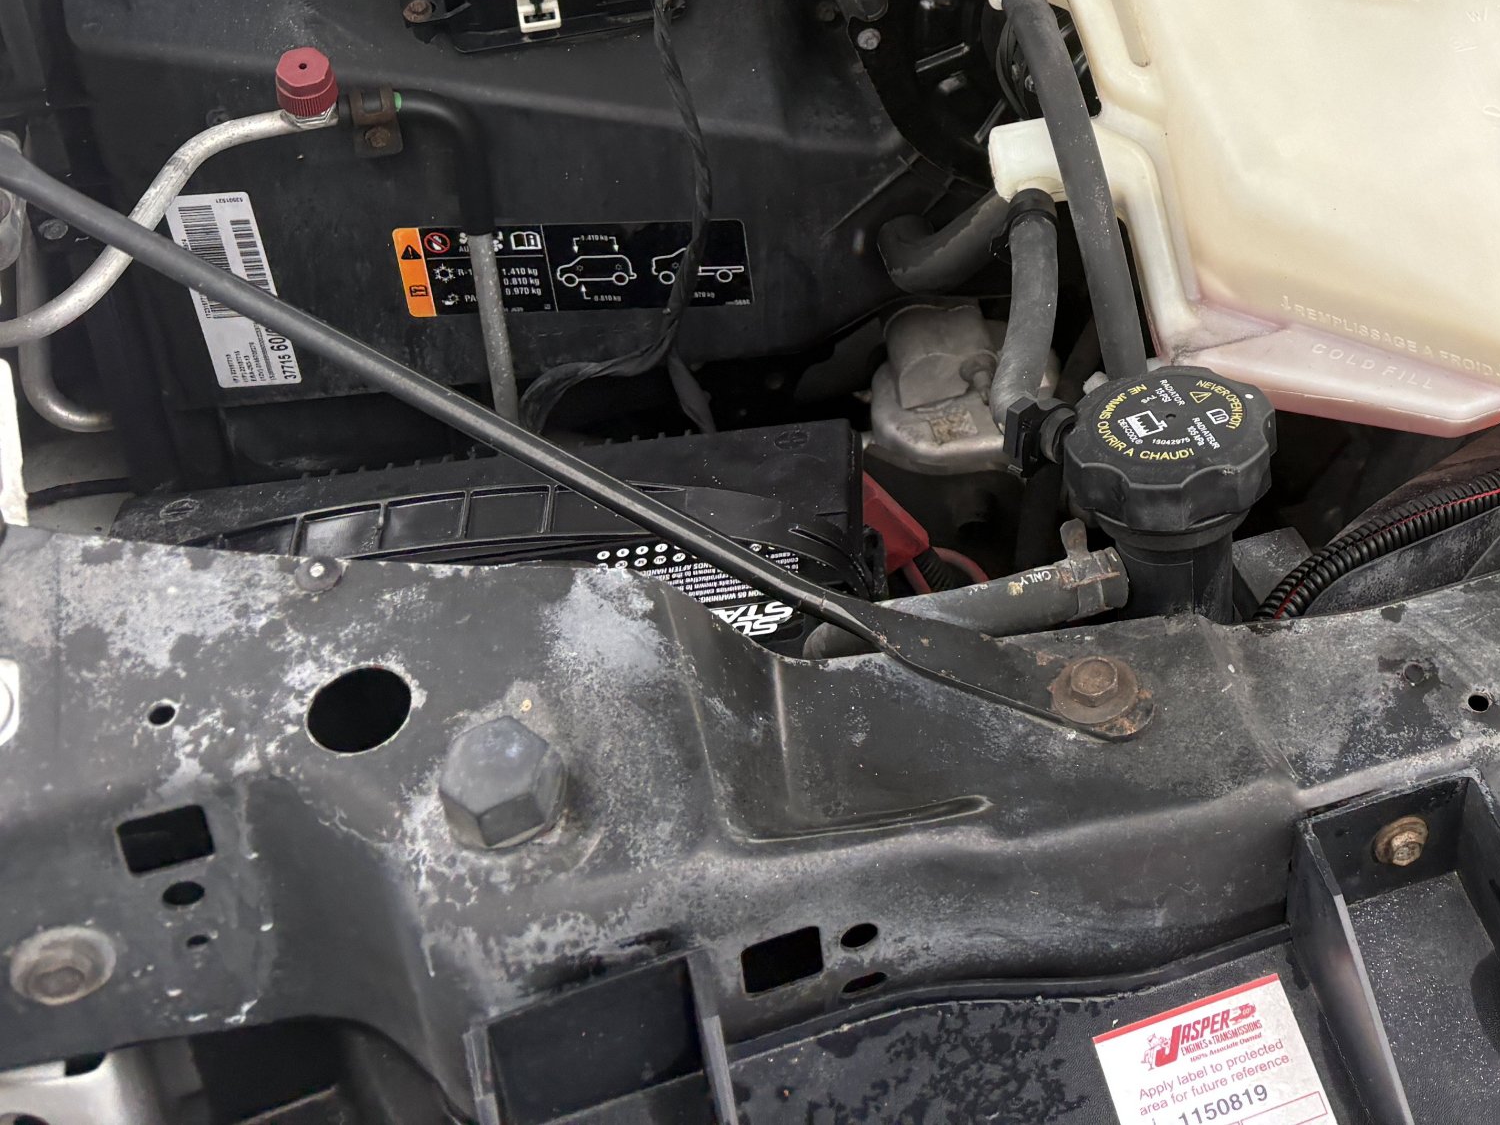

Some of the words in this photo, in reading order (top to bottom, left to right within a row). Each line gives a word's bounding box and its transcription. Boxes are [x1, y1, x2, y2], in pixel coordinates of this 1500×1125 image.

[458, 268, 473, 276] R-1
[528, 267, 538, 276] kg
[503, 278, 528, 286] 0.810
[530, 277, 540, 286] kg
[465, 294, 477, 302] PA
[532, 287, 542, 296] kg
[1295, 305, 1416, 353] REMPLISSAGE
[1440, 350, 1493, 374] FROID
[278, 354, 297, 380] 37715
[1312, 343, 1376, 370] COLD
[1382, 366, 1433, 389] FILL
[1127, 384, 1147, 395] NE
[1160, 379, 1185, 406] RADIATOR
[1196, 380, 1231, 396] NEVER
[1099, 393, 1127, 419] JAMAIS
[1226, 394, 1243, 413] OPEN
[1192, 417, 1220, 449] RADIATEUR
[1226, 413, 1243, 429] HOT!
[1097, 421, 1127, 451] OUVRIR
[669, 564, 692, 574] AFTER
[1020, 570, 1051, 586] ONLY
[700, 593, 736, 603] WARNING:
[709, 601, 793, 623] STA
[733, 619, 778, 636] SU
[1155, 1009, 1230, 1067] JASPER
[1181, 1039, 1209, 1056] ENGINES
[1212, 1019, 1263, 1045] TRANSMISSIONS
[1190, 1053, 1208, 1063] 100%
[1209, 1041, 1238, 1055] Associate
[1239, 1032, 1262, 1045] Owned
[1139, 1080, 1174, 1101] Apply
[1177, 1066, 1208, 1086] label
[1210, 1062, 1223, 1074] to
[1226, 1039, 1284, 1071] protected
[1140, 1100, 1168, 1116] area
[1170, 1090, 1188, 1104] for
[1191, 1077, 1228, 1097] future
[1231, 1054, 1293, 1082] reference.
[1178, 1084, 1268, 1125] 1150819
